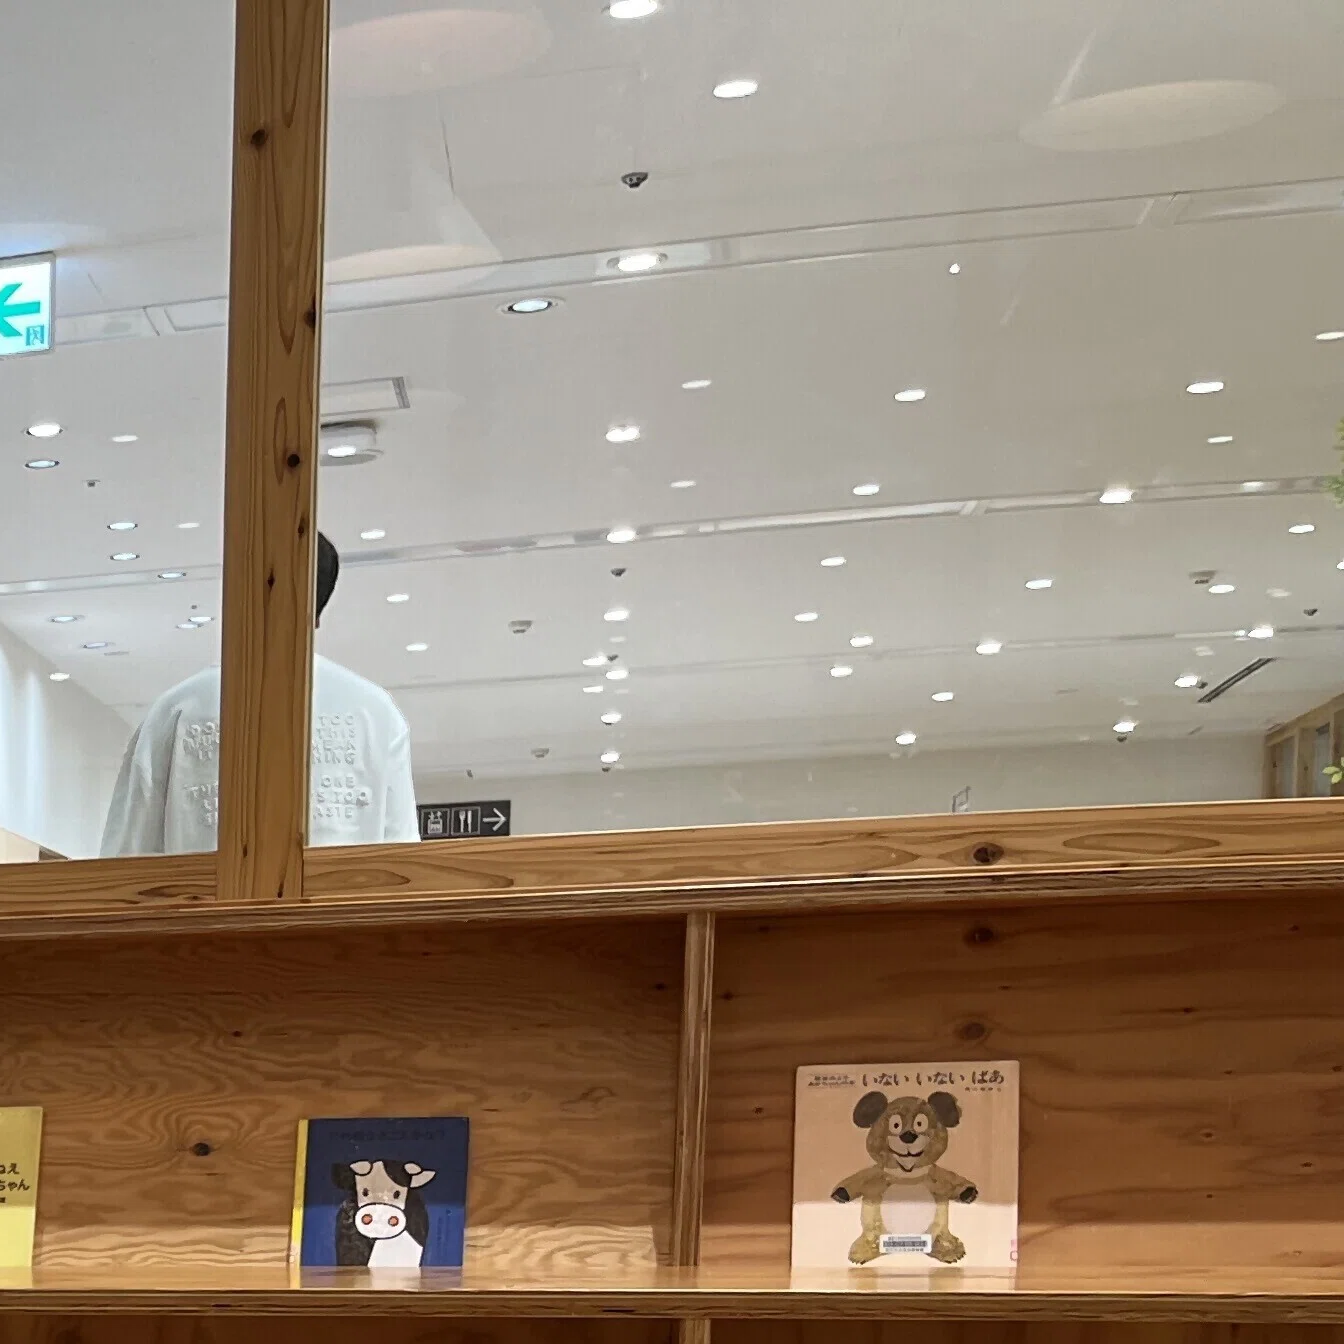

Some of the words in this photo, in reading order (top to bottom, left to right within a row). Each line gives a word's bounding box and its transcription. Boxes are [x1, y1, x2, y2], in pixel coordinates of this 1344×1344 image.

[863, 1073, 910, 1086] いない
[916, 1072, 965, 1085] いない
[971, 1069, 1004, 1085] ばあ
